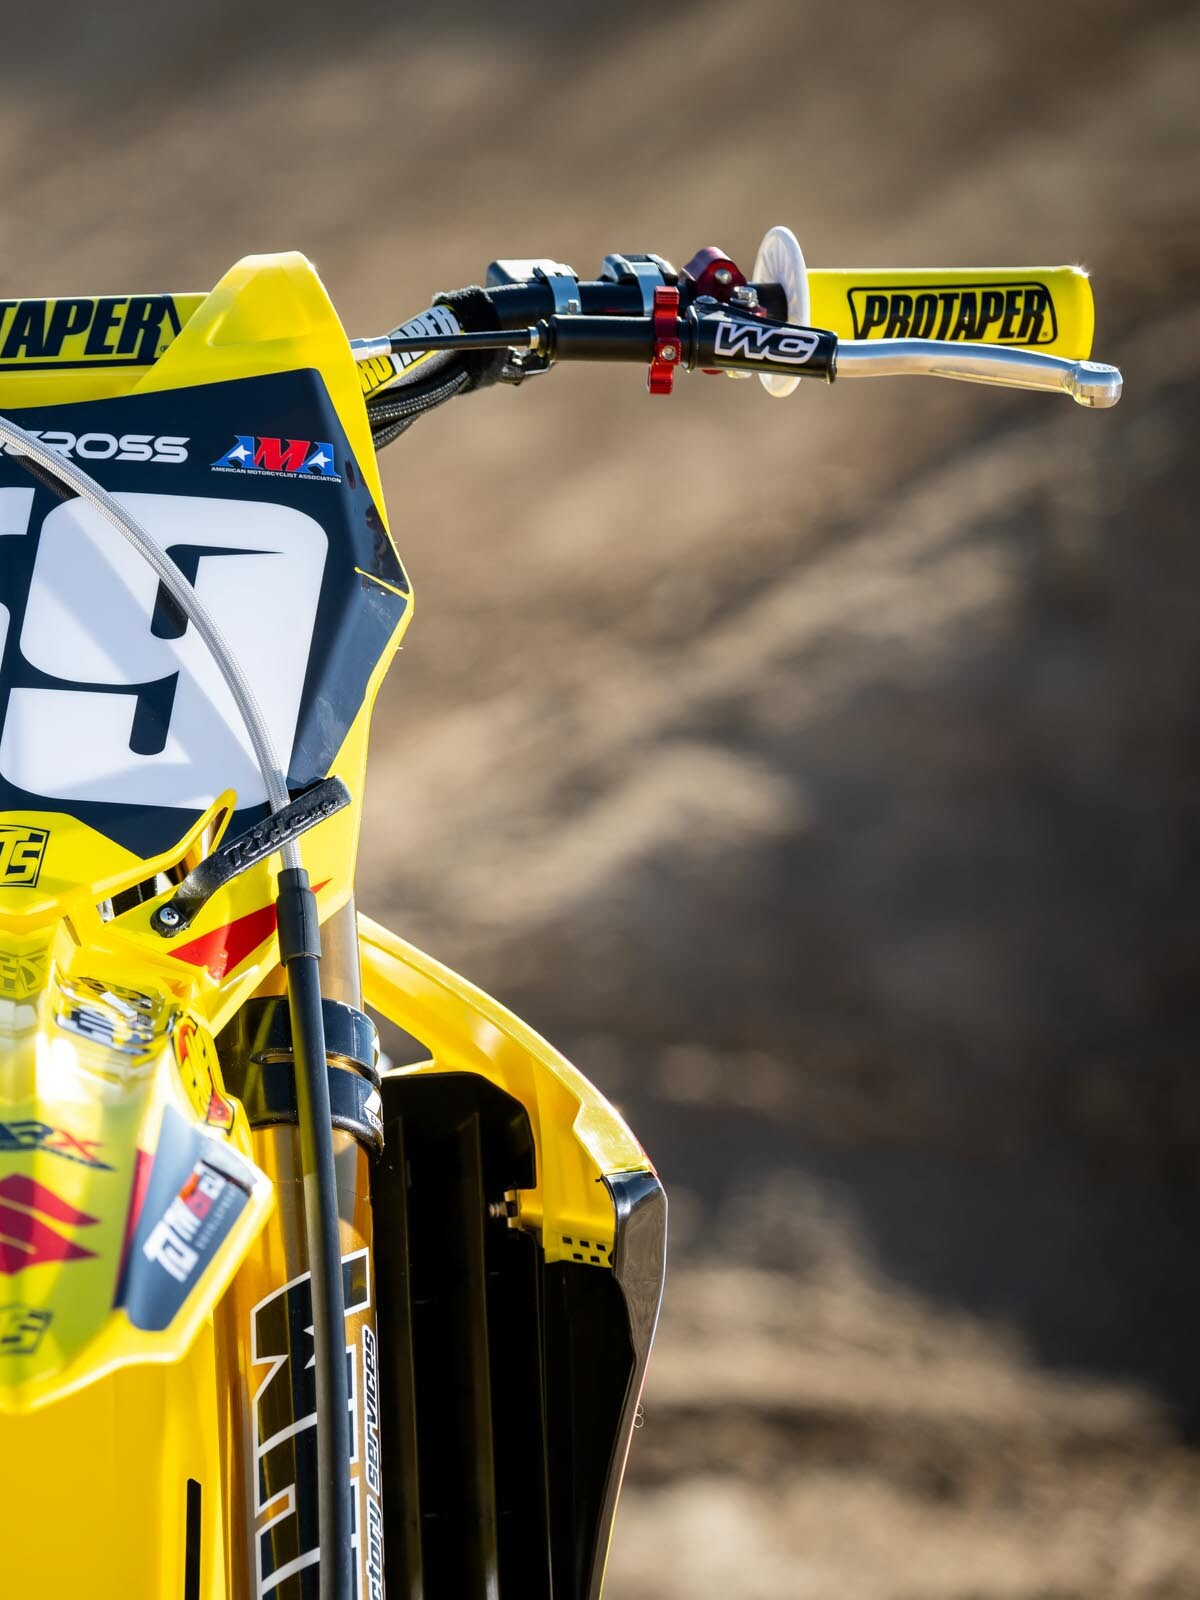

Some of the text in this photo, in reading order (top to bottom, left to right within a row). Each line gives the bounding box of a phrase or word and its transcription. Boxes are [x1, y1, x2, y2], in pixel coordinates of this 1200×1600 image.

[857, 290, 1047, 345] PROTAPER
[210, 434, 341, 477] AMA
[211, 466, 342, 483] AMERICAN MOTORCYCLIST ASSOCIATION
[361, 1324, 380, 1496] services
